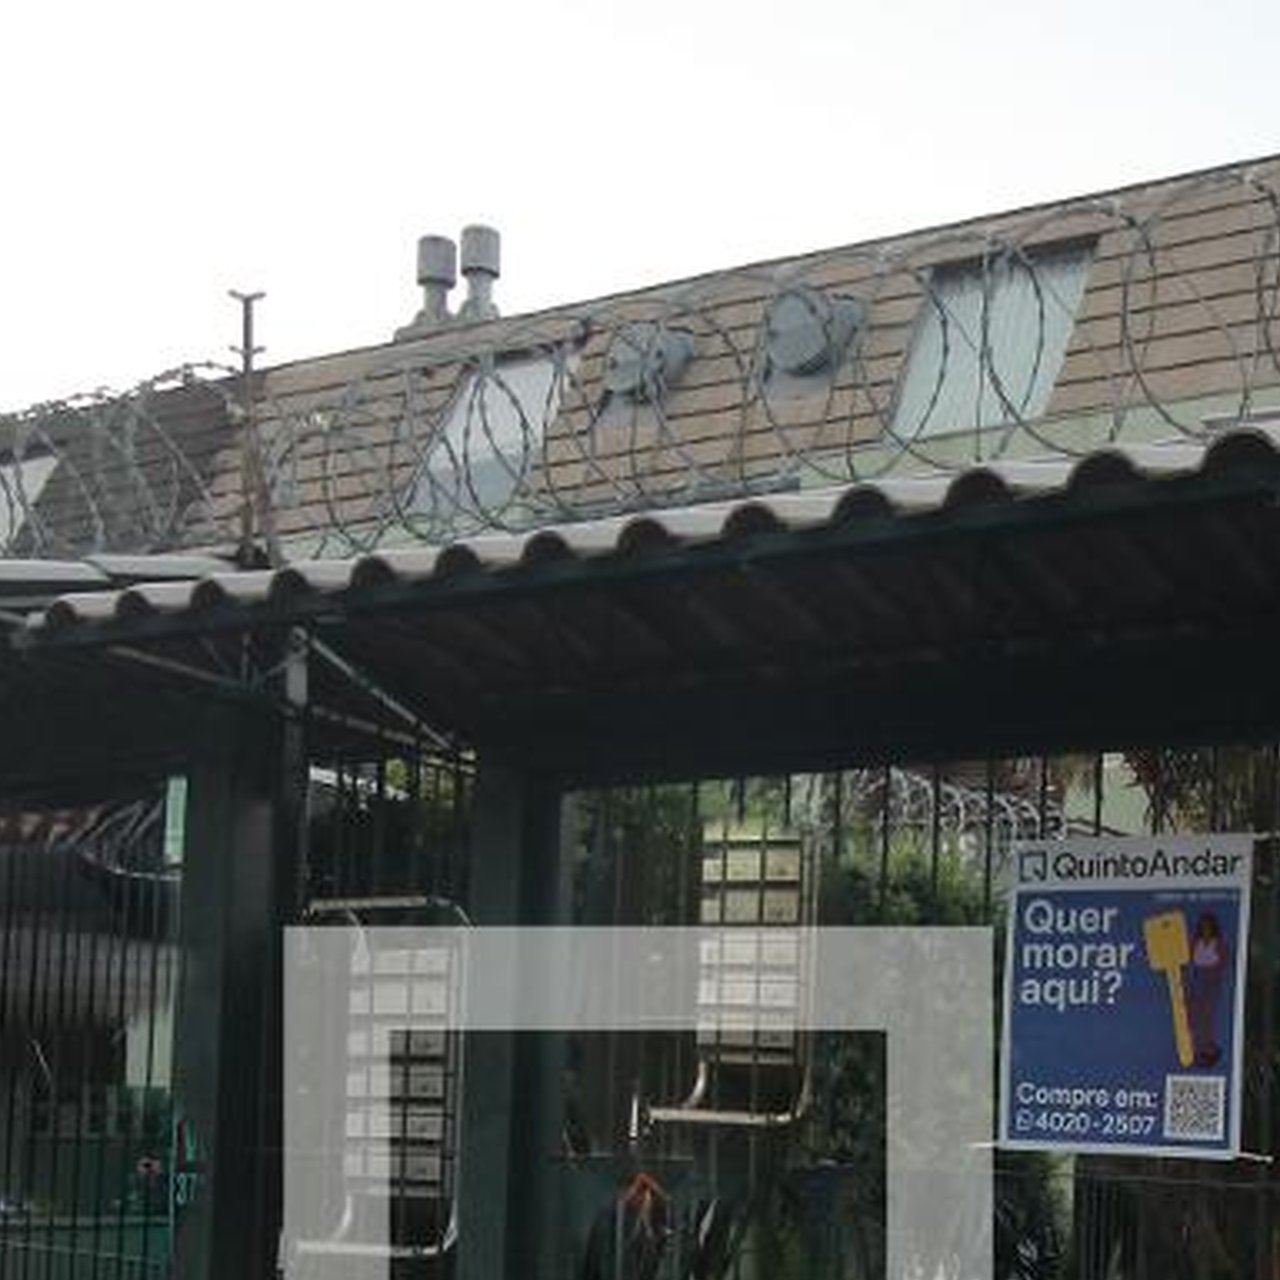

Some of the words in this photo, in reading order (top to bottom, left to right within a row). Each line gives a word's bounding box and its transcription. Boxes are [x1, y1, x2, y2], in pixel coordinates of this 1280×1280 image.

[1053, 848, 1242, 880] QuintoAndar
[1024, 900, 1118, 935] Quer
[1022, 939, 1135, 969] morar
[1020, 972, 1122, 1011] aqui?
[1016, 1082, 1109, 1110] Compre
[1115, 1090, 1158, 1108] em:
